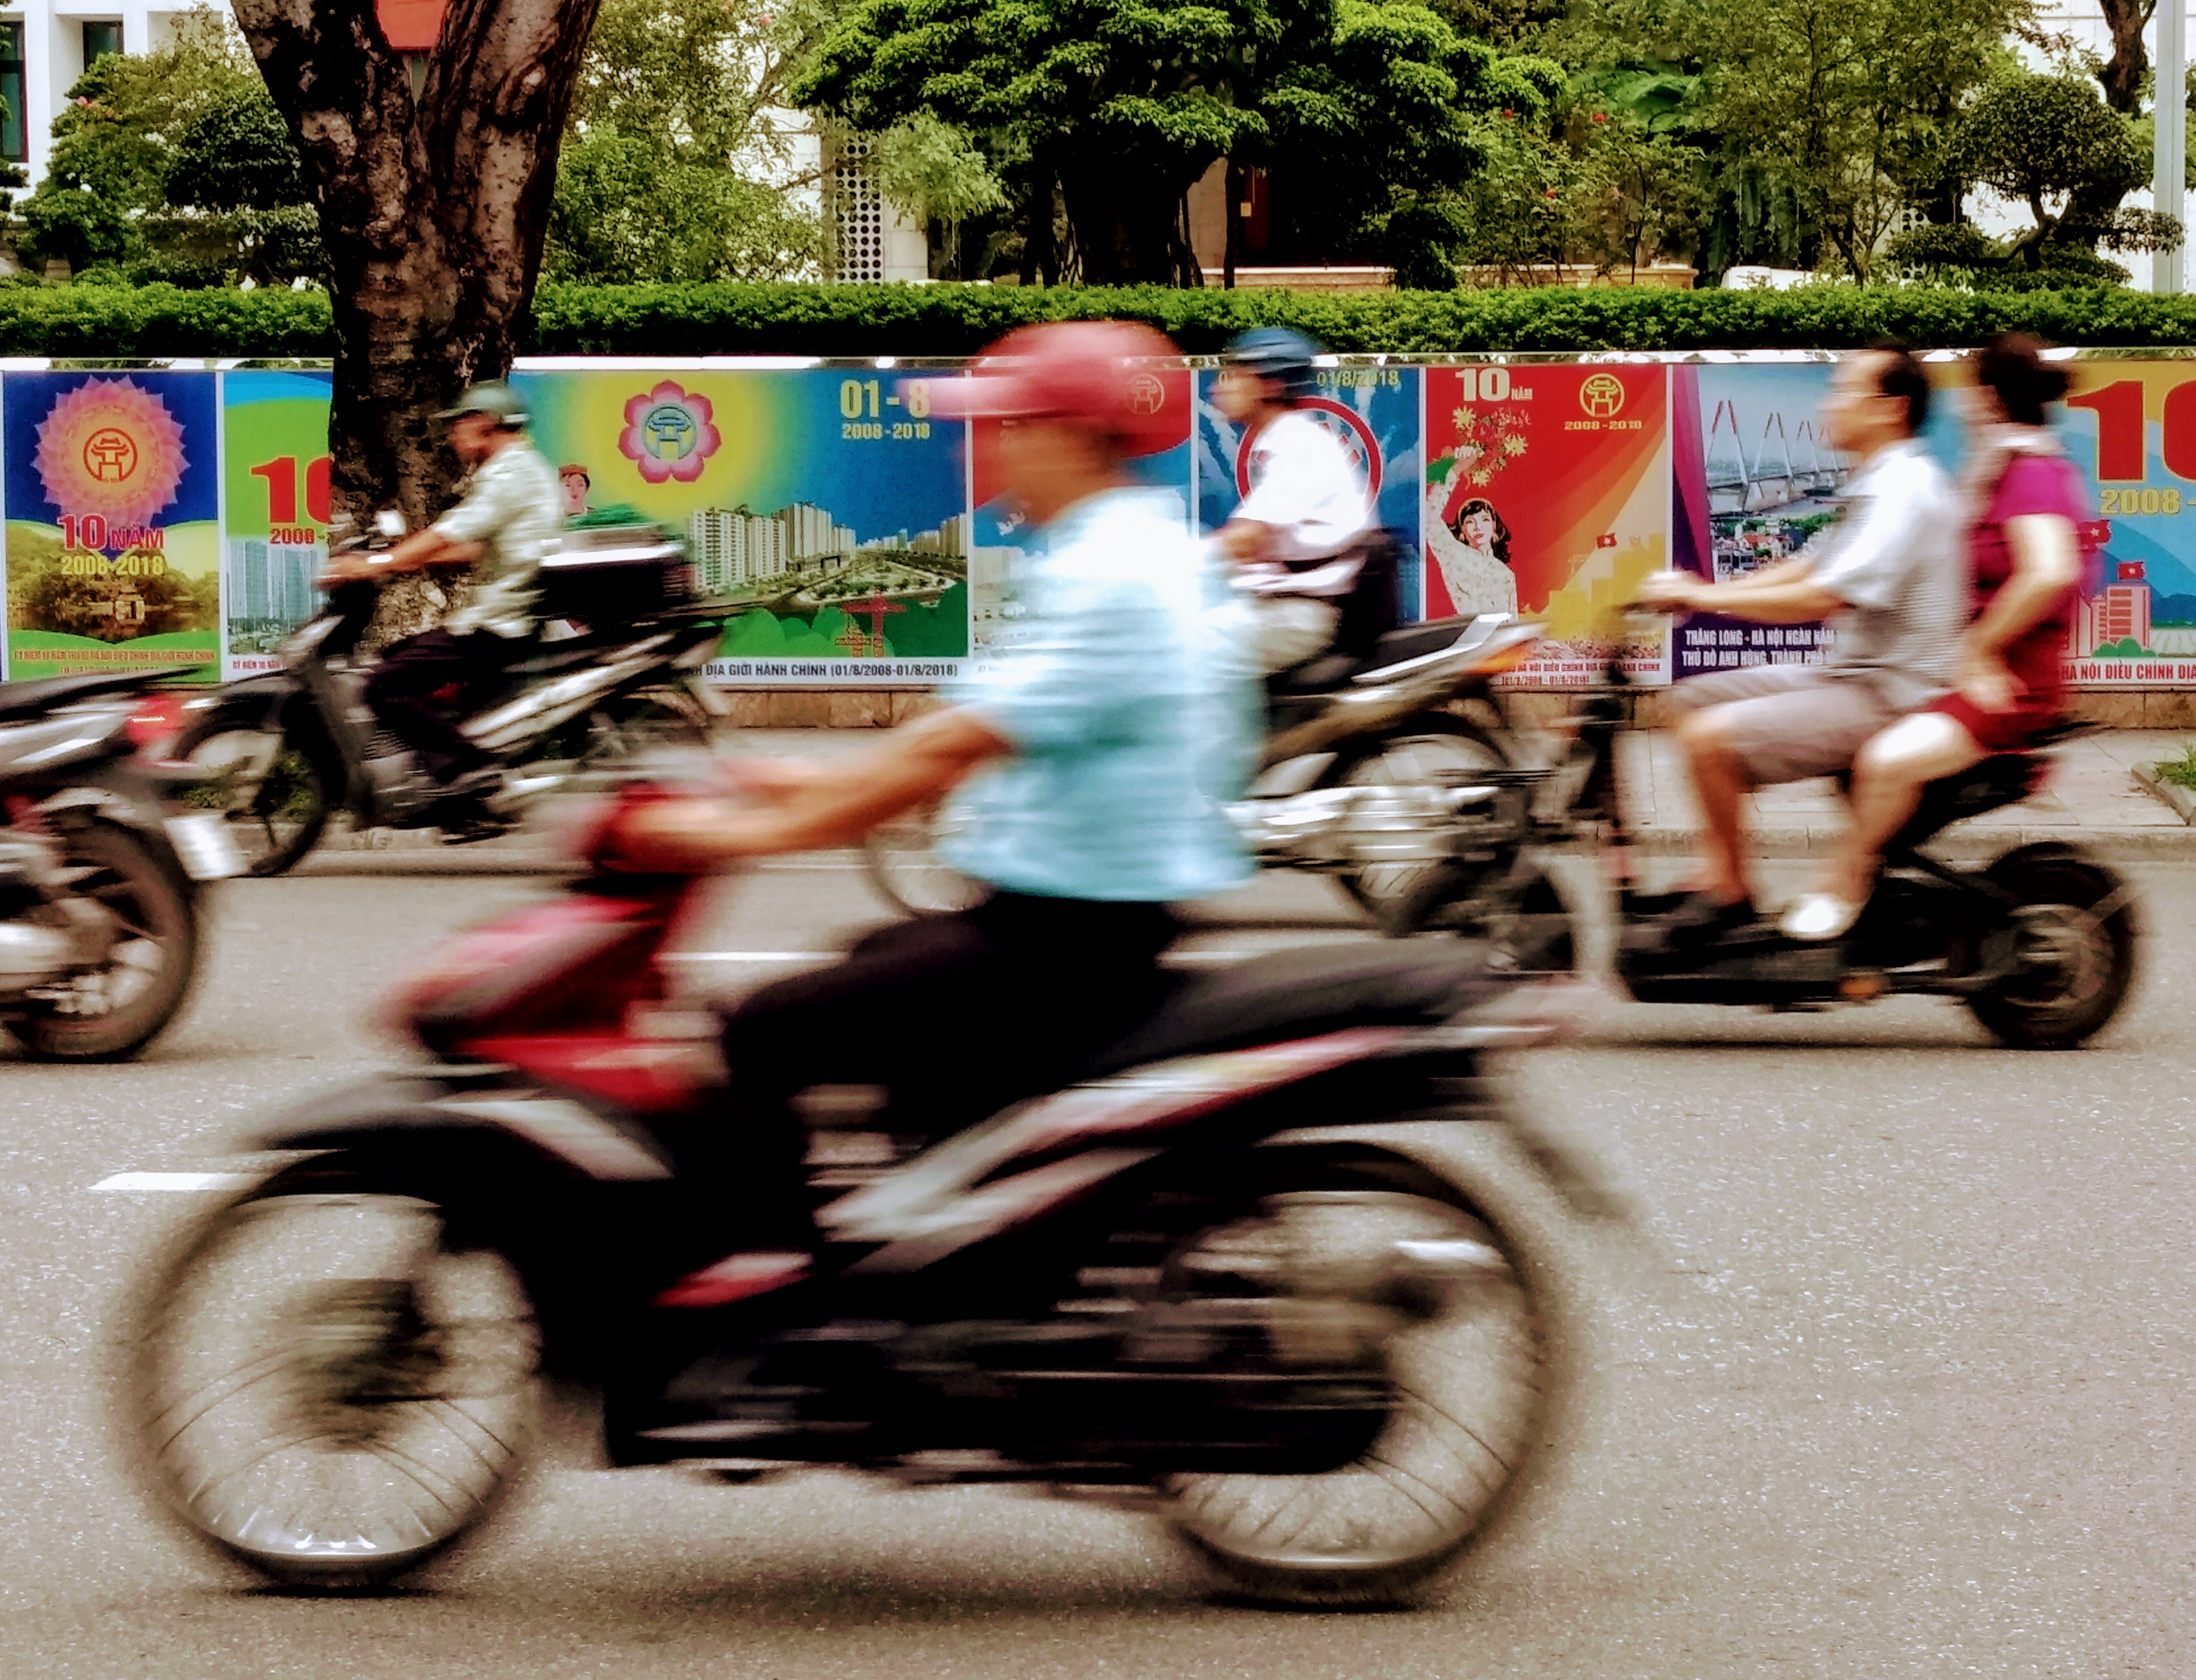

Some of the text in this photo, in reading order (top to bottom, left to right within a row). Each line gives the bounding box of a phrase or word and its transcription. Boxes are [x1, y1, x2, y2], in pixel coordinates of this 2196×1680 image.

[840, 379, 879, 419] 01
[908, 380, 931, 419] 8
[1455, 367, 1510, 401] 10
[2099, 487, 2180, 515] 2008
[57, 514, 164, 550] 10 NĂM
[1719, 629, 1744, 646] LONG
